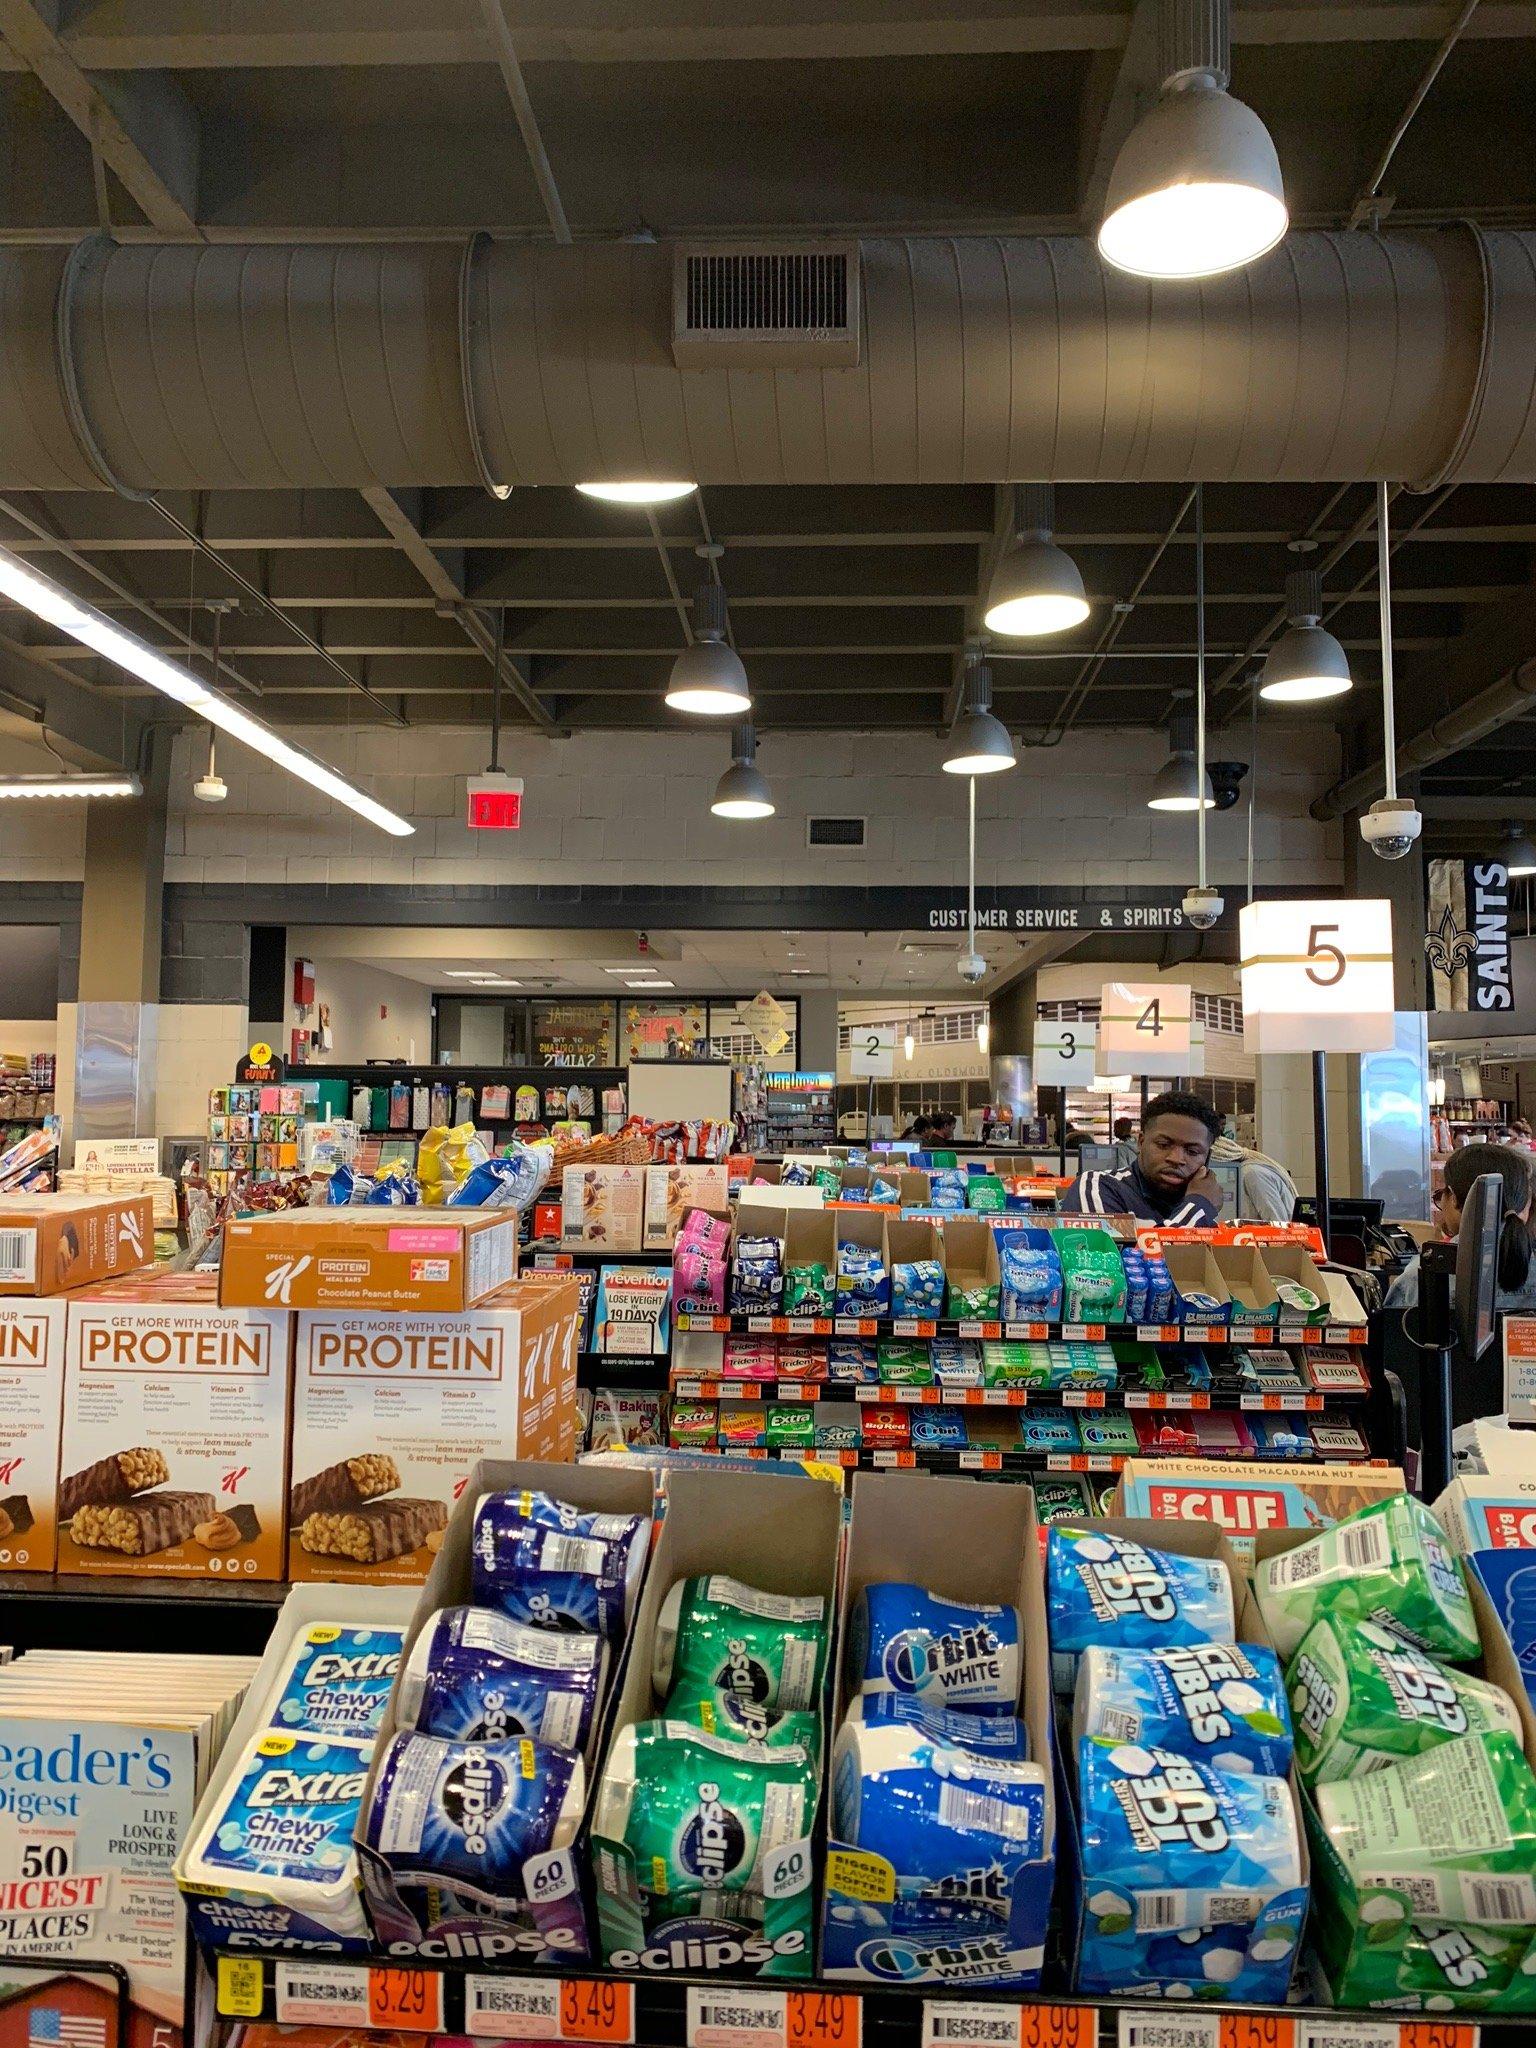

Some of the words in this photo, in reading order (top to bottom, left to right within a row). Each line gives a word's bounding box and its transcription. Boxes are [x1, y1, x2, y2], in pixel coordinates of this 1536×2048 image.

[1015, 908, 1079, 928] SERVICE
[1100, 908, 1113, 927] &
[1123, 907, 1183, 927] SPIRITS
[1474, 862, 1511, 1011] SAINTS
[1305, 924, 1346, 987] 5
[1136, 998, 1164, 1037] 4
[866, 1035, 879, 1057] 2
[1058, 1032, 1077, 1060] 3
[265, 1253, 295, 1261] SPECIAL
[321, 1261, 368, 1273] PROTEIN
[264, 1255, 314, 1304] K
[521, 1269, 592, 1284] Prevention
[602, 1270, 671, 1287] Prevention
[317, 1288, 360, 1298] Chocolate
[362, 1289, 391, 1298] Peanut
[393, 1289, 421, 1299] Butter
[609, 1294, 629, 1304] LOSE
[630, 1295, 663, 1306] WEIGHT
[677, 1297, 721, 1313] Orbit
[729, 1301, 779, 1315] eclipse
[785, 1300, 833, 1316] eclipse
[111, 1317, 133, 1327] GET
[136, 1317, 171, 1328] MORE
[173, 1318, 203, 1329] WITH
[206, 1319, 239, 1330] YOUR
[610, 1309, 623, 1321] 19
[625, 1309, 657, 1323] DAYS
[341, 1320, 364, 1331] GET
[367, 1321, 402, 1332] MORE
[405, 1322, 435, 1333] WITH
[437, 1322, 471, 1333] YOUR
[88, 1329, 261, 1367] PROTEIN
[318, 1333, 494, 1372] PROTEIN
[729, 1357, 762, 1367] Trident
[780, 1357, 814, 1369] Trident
[832, 1364, 865, 1374] Trident
[884, 1365, 917, 1377] Trident
[1318, 1368, 1358, 1378] ALTOIDS
[78, 1382, 115, 1391] Magnesium
[143, 1383, 170, 1392] Calcium
[210, 1385, 236, 1393] Vitamin
[993, 1376, 1043, 1388] Extra
[1059, 1379, 1109, 1390] Extra
[1259, 1378, 1299, 1387] ALTOIDS
[307, 1386, 345, 1396] Magnesium
[374, 1388, 401, 1397] Calcium
[441, 1390, 468, 1398] Vitamin
[469, 1390, 476, 1398] D
[620, 1400, 658, 1413] Baking
[674, 1412, 714, 1424] Extra
[771, 1413, 810, 1427] Extra
[865, 1422, 884, 1431] Big
[885, 1422, 906, 1431] Red
[912, 1421, 960, 1442] Orbit
[1027, 1425, 1071, 1441] Orbit
[1084, 1426, 1129, 1445] Orbit
[1318, 1434, 1358, 1446] ALTOIDS
[204, 1439, 221, 1447] lean
[223, 1439, 252, 1447] muscle
[435, 1445, 453, 1453] lean
[455, 1446, 484, 1454] muscle
[184, 1449, 210, 1458] strong
[212, 1449, 236, 1457] bones
[416, 1455, 442, 1465] strong
[443, 1456, 468, 1464] bones
[1147, 1462, 1182, 1471] WHITE
[1185, 1463, 1255, 1475] CHOCOLATE
[1258, 1467, 1328, 1478] MACADAMIA
[1332, 1470, 1355, 1479] NUT
[221, 1467, 248, 1494] K
[1037, 1487, 1079, 1503] eclipse
[1180, 1492, 1278, 1529] CLIF
[480, 1518, 497, 1573] eclipse
[1092, 1560, 1142, 1613] ICE
[312, 1630, 334, 1639] NEW!
[882, 1622, 1000, 1694] Orbit
[1187, 1643, 1242, 1682] ICE
[939, 1660, 1001, 1688] WHITE
[1384, 1650, 1442, 1716] ICE
[304, 1688, 390, 1711] chewy
[946, 1687, 982, 1697] PEPPERMINT
[1152, 1645, 1232, 1744] CUBES
[305, 1705, 372, 1722] mints
[309, 1721, 361, 1730] peppermint
[263, 1740, 287, 1750] NEW!
[246, 1769, 368, 1808] Extra
[462, 1745, 494, 1856] eclipse
[1129, 1775, 1189, 1842] ICE
[143, 1809, 178, 1826] LIVE
[123, 1823, 163, 1841] LONG
[166, 1825, 177, 1841] &
[246, 1811, 336, 1842] chewy
[695, 1781, 729, 1890] eclipse
[108, 1839, 176, 1858] PROSPER
[244, 1833, 317, 1857] mints
[22, 1845, 68, 1878] 50
[773, 1852, 804, 1883] 60
[834, 1855, 887, 1878] BIGGER
[533, 1860, 564, 1891] 60
[834, 1864, 886, 1885] FLAVOR
[535, 1878, 567, 1900] PIECES
[773, 1873, 806, 1895] PIECES
[834, 1873, 887, 1895] SOFTER
[129, 1894, 146, 1904] The
[149, 1896, 175, 1907] Worst
[119, 1907, 150, 1917] Advice
[151, 1909, 175, 1919] Ever!
[198, 1900, 292, 1926] chewy
[1264, 1902, 1302, 1922] GUM
[210, 1913, 289, 1933] mints
[105, 1934, 112, 1943] A
[388, 1927, 584, 1959] eclipse
[20, 1941, 74, 1954] AMERICA
[142, 1947, 172, 1959] Racket
[609, 1929, 806, 1971] eclipse
[856, 1936, 1011, 1982] Orbit
[935, 1960, 1014, 1979] WHITE
